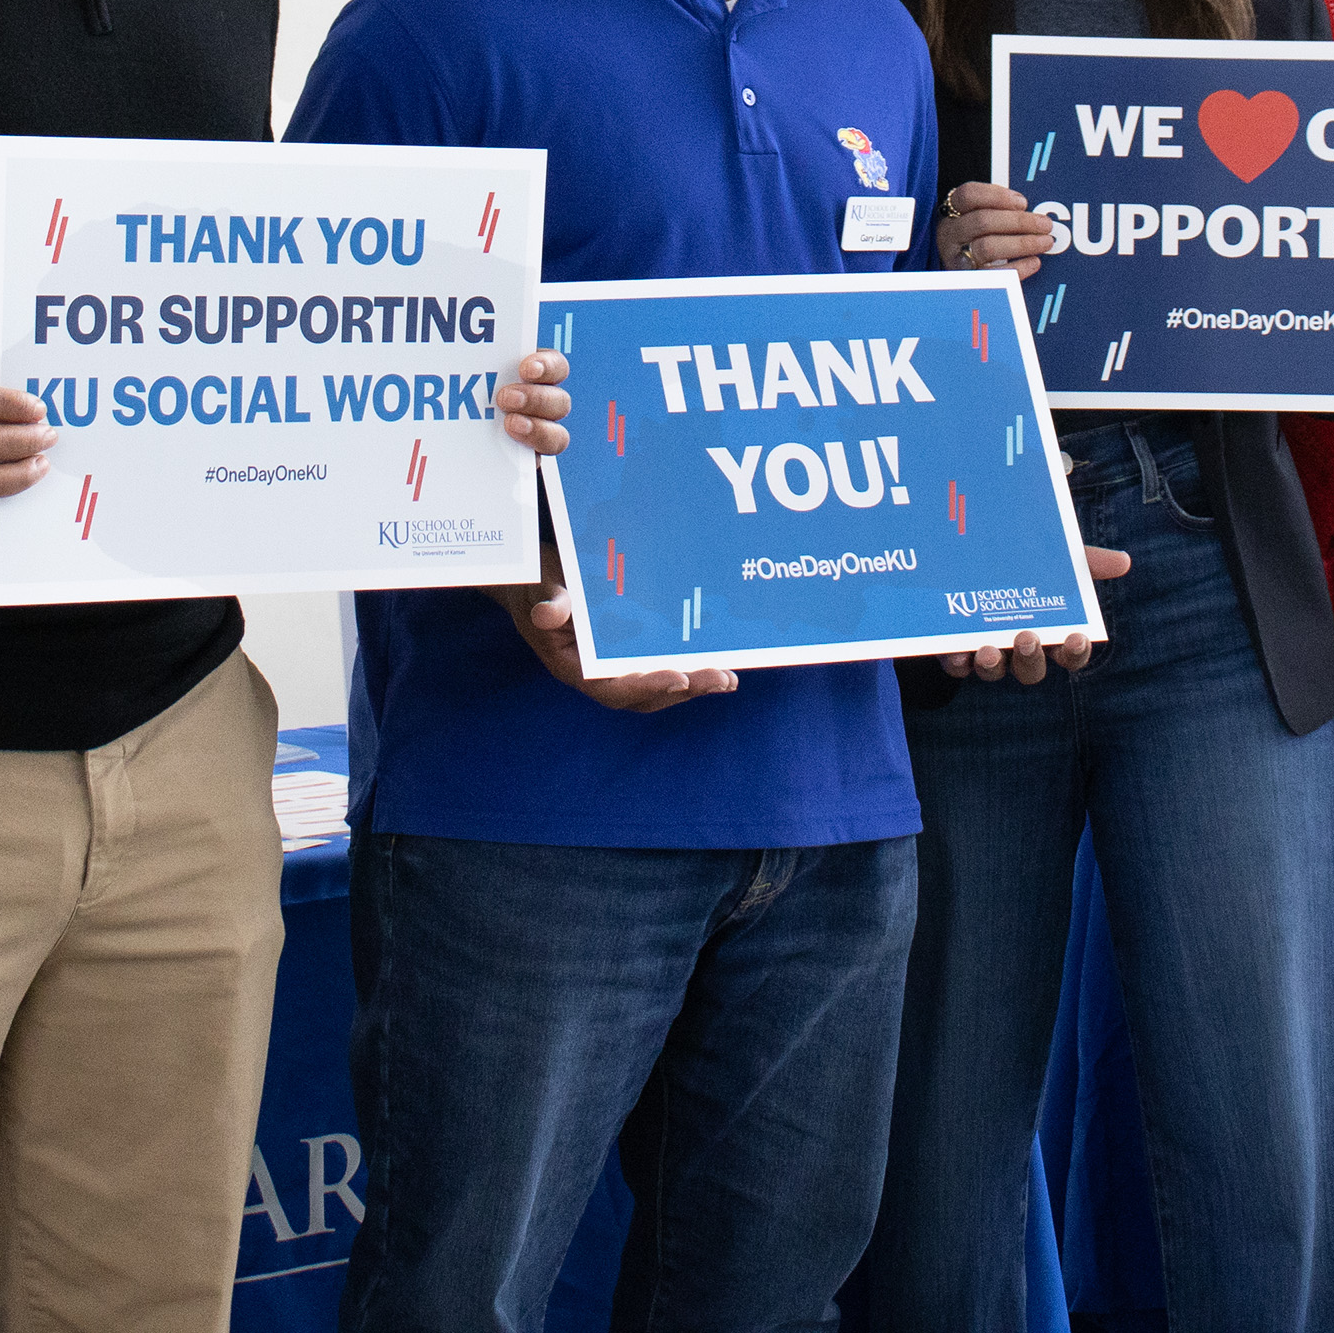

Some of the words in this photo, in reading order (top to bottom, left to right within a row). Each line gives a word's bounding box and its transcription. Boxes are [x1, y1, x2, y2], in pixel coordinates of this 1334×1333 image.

[1075, 104, 1184, 158] WE
[851, 204, 867, 221] KU
[116, 214, 304, 264] THANK
[317, 218, 425, 266] YOU
[860, 234, 874, 244] Gary
[34, 295, 145, 344] FOR
[158, 295, 496, 344] SUPPORTING
[640, 337, 936, 413] THANK
[26, 377, 98, 427] KU
[112, 375, 310, 426] SOCIAL
[323, 371, 498, 421] WORK!
[205, 464, 328, 485] #OneDayOneKU
[706, 436, 910, 514] YOU!
[378, 521, 410, 548] KU
[412, 519, 457, 531] SCHOOL
[460, 519, 474, 530] OF
[412, 531, 452, 544] SOCIAL
[455, 530, 504, 542] WELFARE
[742, 548, 917, 581] #OneDayOneKU
[944, 591, 979, 617] KU
[977, 588, 1022, 601] SCHOOL
[1023, 587, 1037, 597] OF
[979, 599, 1019, 612] SOCIAL
[1019, 596, 1066, 608] WELFARE
